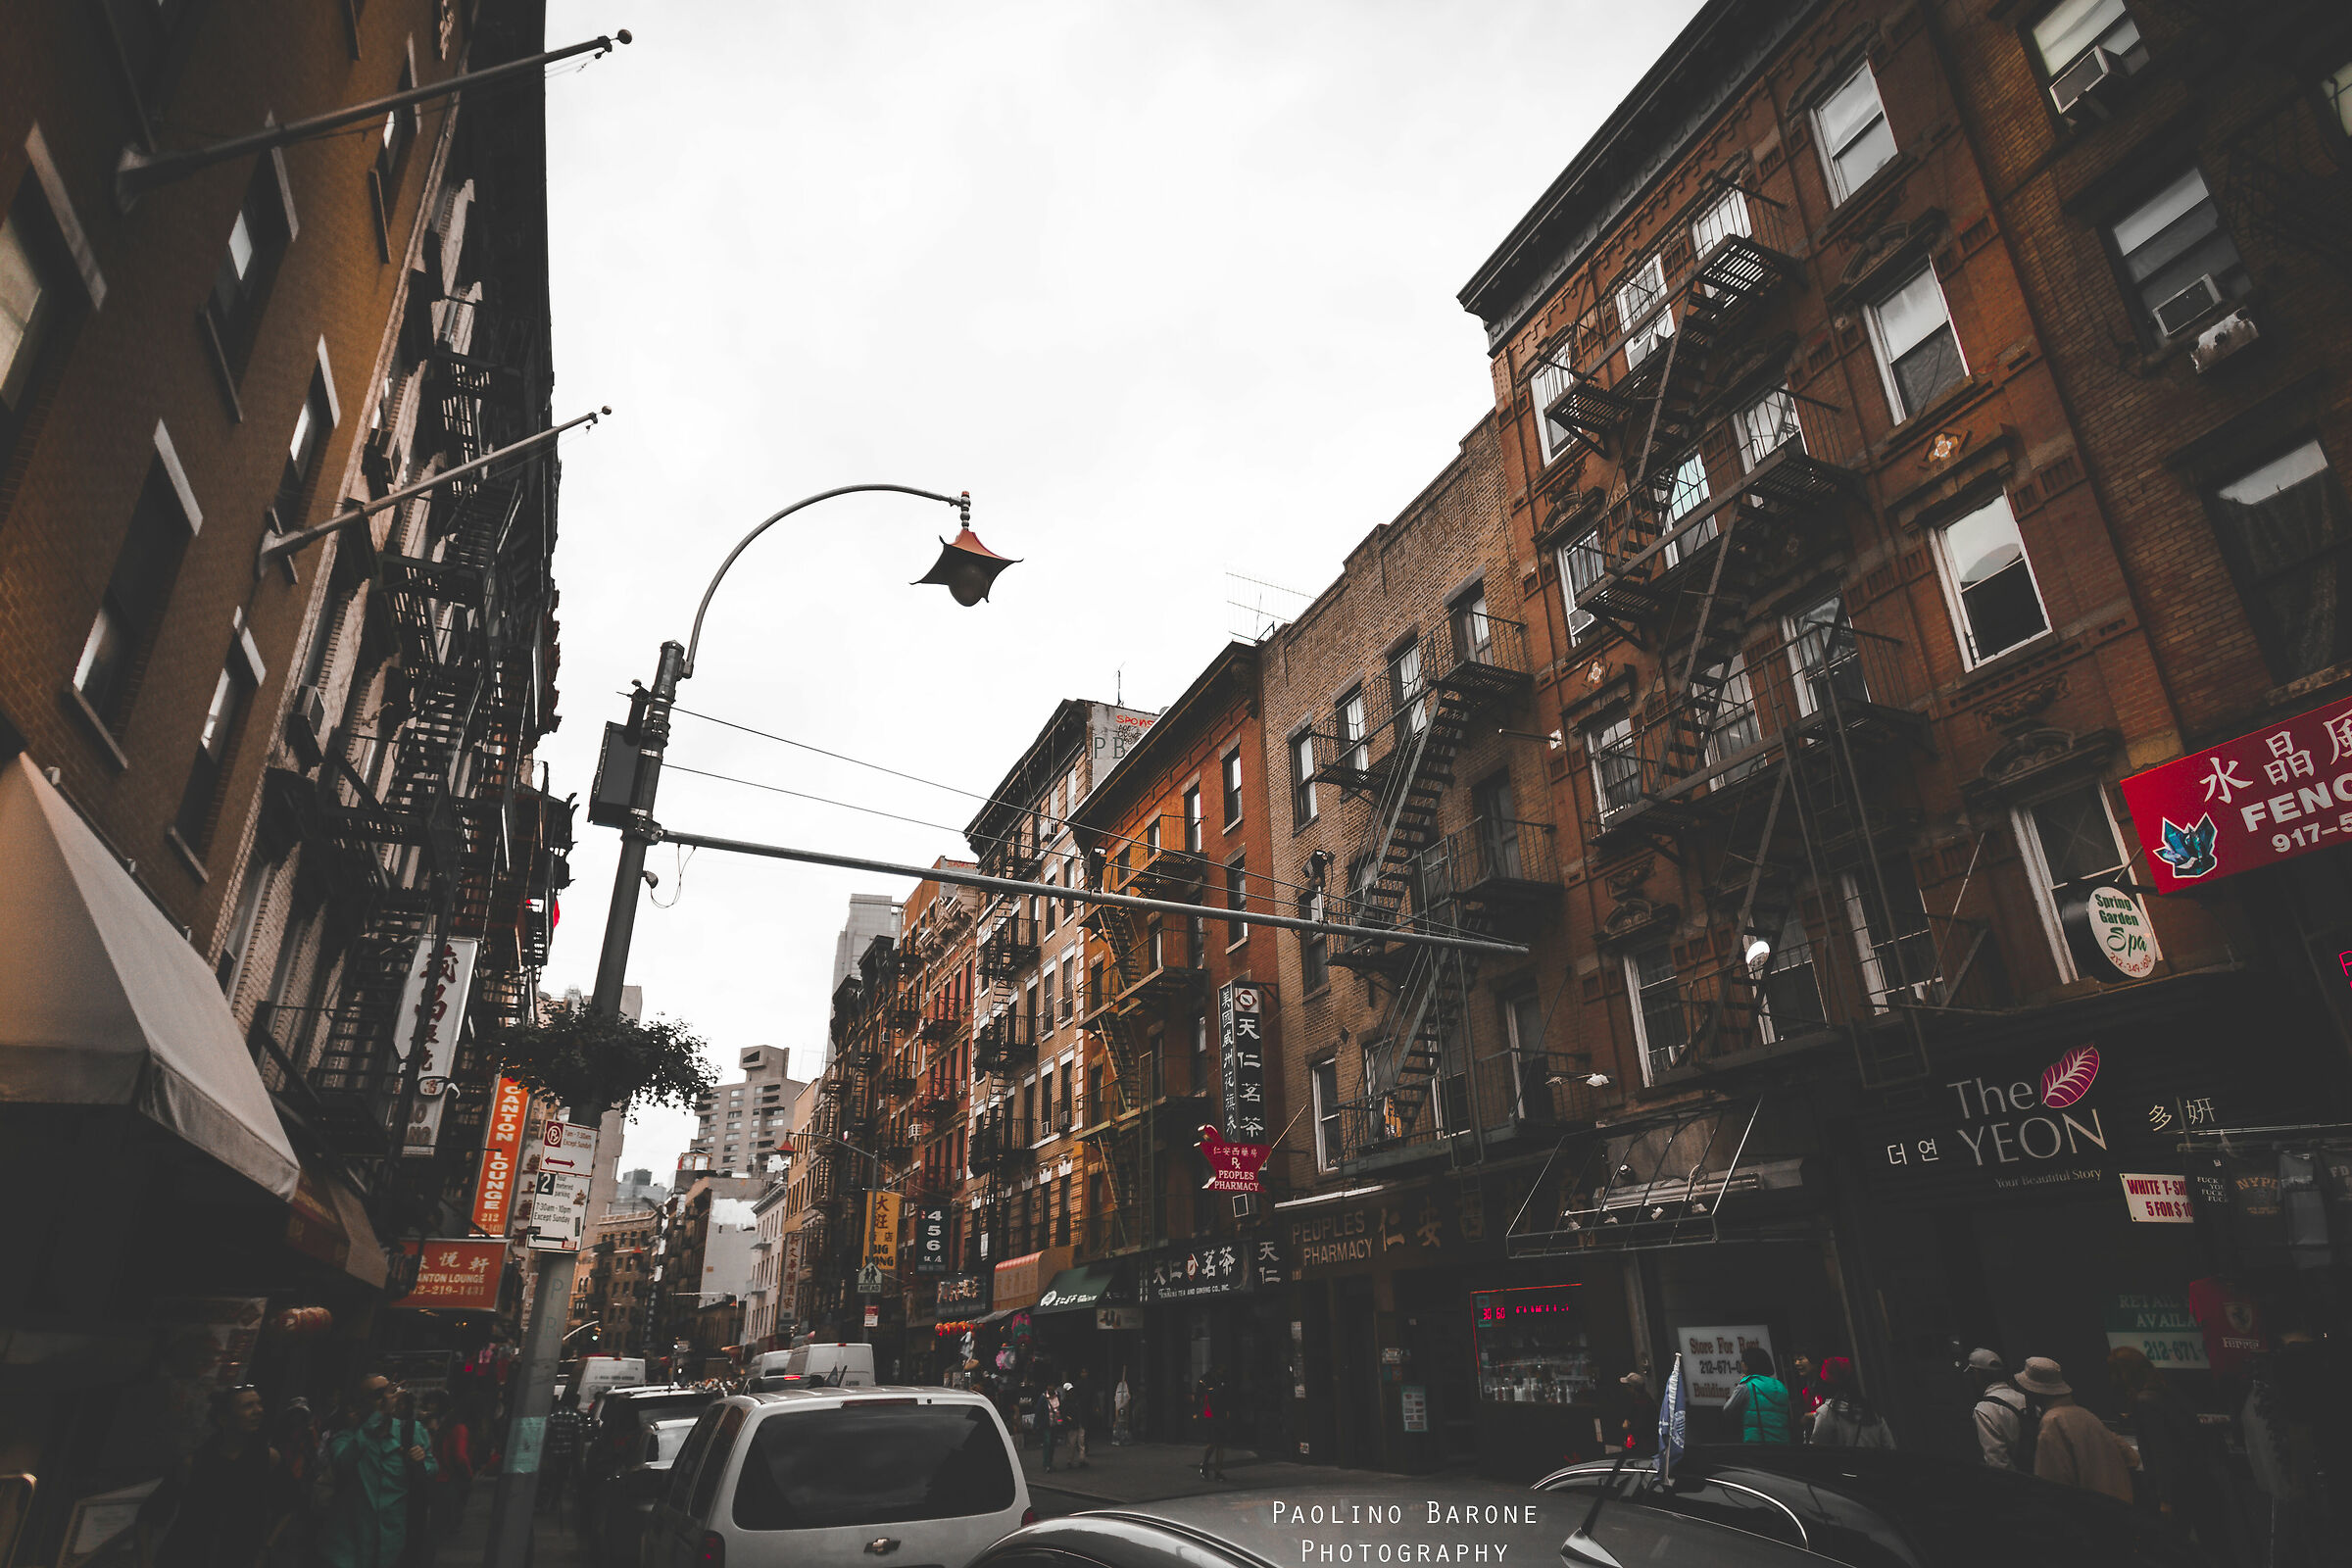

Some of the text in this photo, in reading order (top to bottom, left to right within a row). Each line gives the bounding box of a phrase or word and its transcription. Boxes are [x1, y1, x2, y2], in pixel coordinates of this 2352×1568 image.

[2094, 894, 2132, 911] Spring
[2098, 909, 2139, 926] Garden
[2106, 926, 2147, 957] Spa
[1236, 1017, 1264, 1138] 天仁茗茶
[1946, 1076, 2035, 1120] The
[495, 1085, 521, 1142] CANTON
[1956, 1107, 2108, 1166] YEON
[483, 1151, 510, 1210] LOUNGE
[540, 1173, 552, 1193] 2
[1214, 1180, 1259, 1192] PHARMACY
[1218, 1169, 1254, 1180] PEOPLES
[1993, 1167, 2102, 1191] Your Beautiful Story
[2126, 1179, 2161, 1196] WHITE
[2145, 1200, 2154, 1216] 5
[2154, 1201, 2175, 1217] FOR
[925, 1210, 943, 1251] 456
[1292, 1209, 1365, 1246] PEOPLES
[1302, 1238, 1373, 1267] PHARMACY
[416, 1273, 485, 1284] ANTON LOUNGE
[1689, 1338, 1713, 1354] Store
[1716, 1337, 1734, 1354] For
